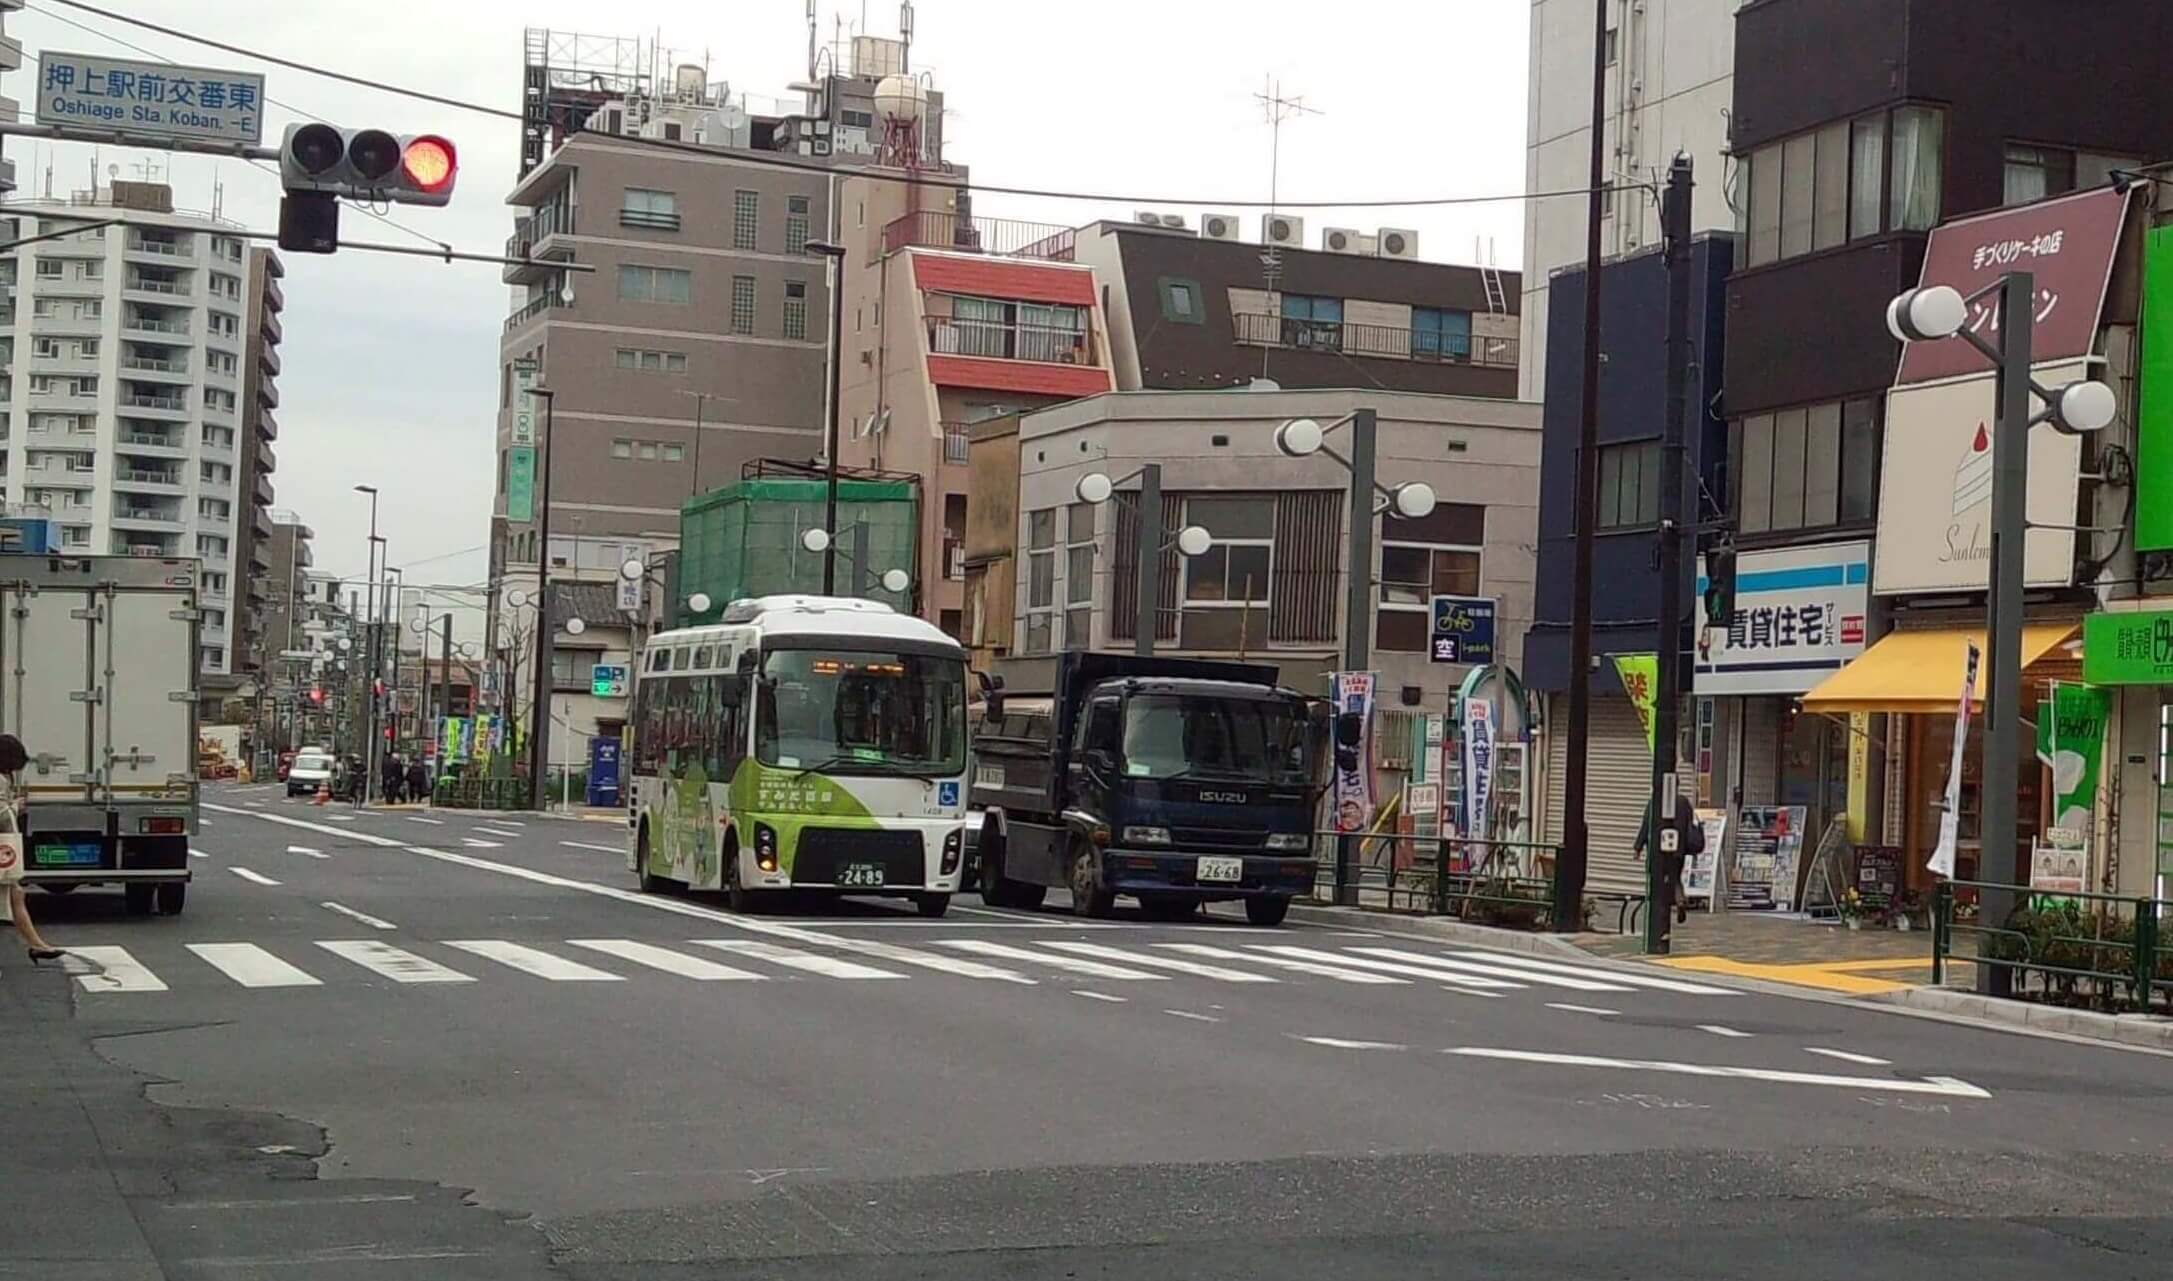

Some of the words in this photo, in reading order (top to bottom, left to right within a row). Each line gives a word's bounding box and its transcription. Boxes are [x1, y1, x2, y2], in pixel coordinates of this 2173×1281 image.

[46, 62, 257, 112] 押上駅前交番東
[52, 97, 125, 121] Oshiage
[131, 105, 166, 124] Sta.
[169, 109, 223, 130] Koban.
[1973, 229, 2064, 271] 手づくりケーキの店
[1938, 521, 1991, 562] Sunlem
[1726, 604, 1824, 650] 賃貸住宅
[1824, 602, 1835, 646] サービス
[1435, 638, 1456, 659] 空
[1199, 790, 1247, 804] ISUZU
[844, 870, 884, 886] 24-89
